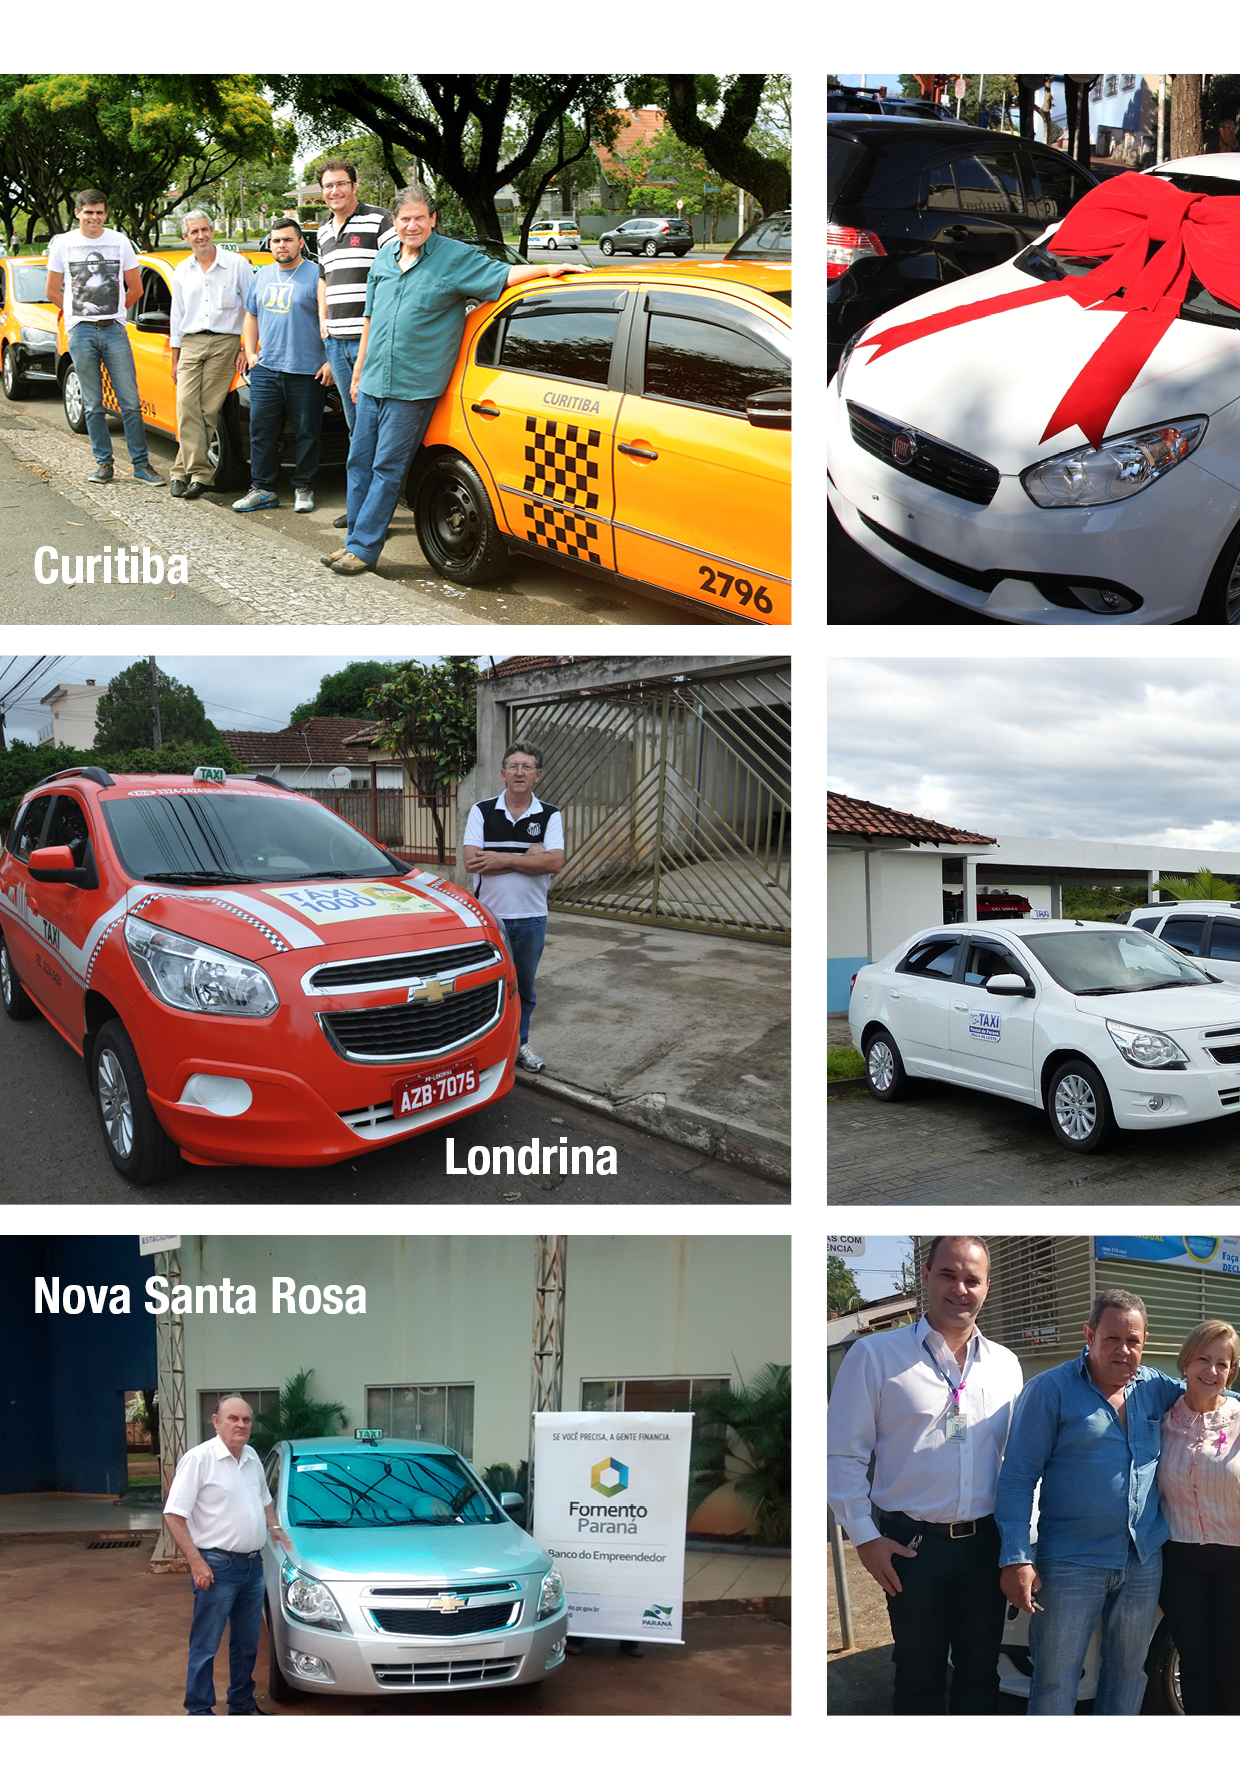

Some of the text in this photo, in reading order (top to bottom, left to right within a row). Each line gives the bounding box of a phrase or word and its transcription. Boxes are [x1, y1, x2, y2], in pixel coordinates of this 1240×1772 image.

[221, 243, 237, 252] TAXI
[543, 391, 600, 414] CURITIBA
[896, 439, 909, 457] FIAT
[699, 565, 773, 614] 2796
[200, 768, 224, 780] TAXI
[279, 888, 360, 902] TÁXI
[301, 897, 377, 912] 1000
[1034, 910, 1050, 918] TAXI
[43, 919, 60, 950] TÁXI
[979, 1013, 999, 1028] TAXI
[840, 1235, 862, 1244] COM
[1222, 1252, 1239, 1263] Faça
[358, 1430, 381, 1438] TAXI
[552, 1431, 671, 1442] SE VOCÊ PRECISA, A GENTE FINANCIA.
[569, 1501, 648, 1519] Fomento
[578, 1518, 638, 1535] Paraná
[548, 1549, 667, 1563] Banco do Empreendedor
